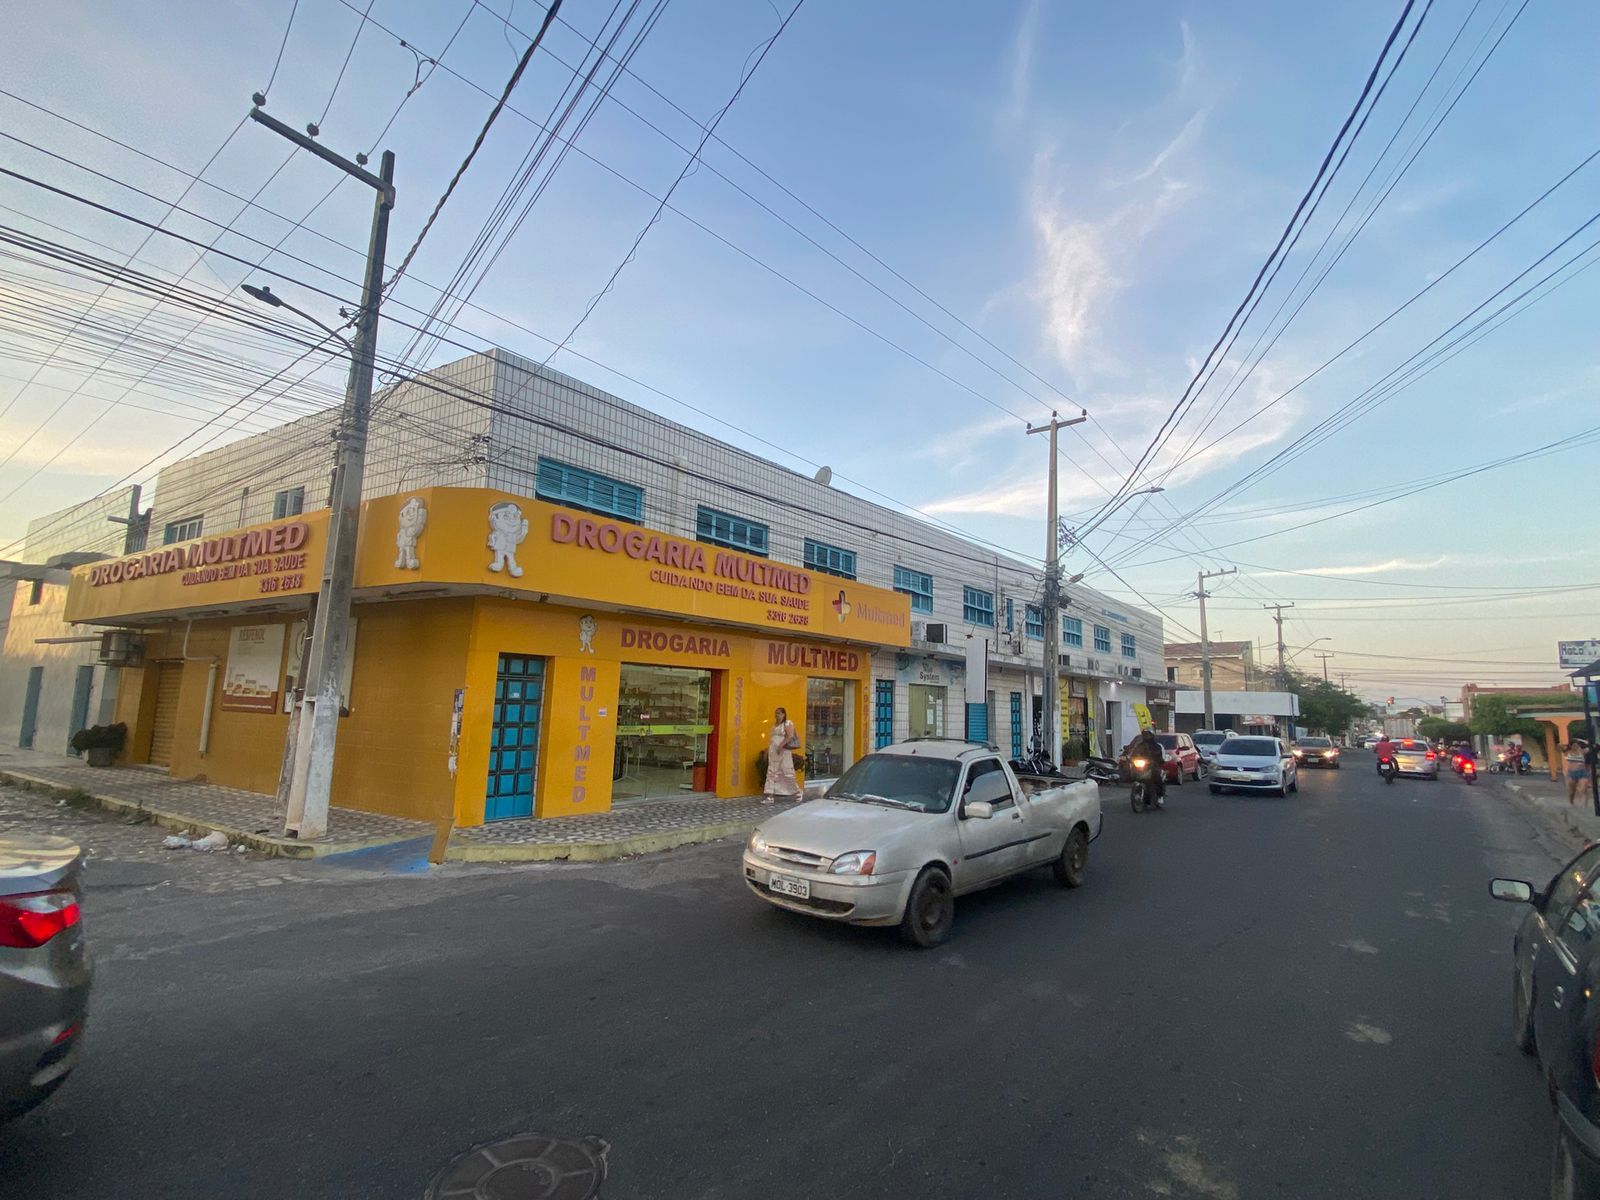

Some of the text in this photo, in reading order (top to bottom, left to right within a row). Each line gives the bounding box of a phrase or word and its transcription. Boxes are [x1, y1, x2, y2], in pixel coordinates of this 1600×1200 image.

[90, 521, 308, 586] DROGARIA MULTMED
[552, 511, 811, 594] DROGARIA MULTMED
[650, 569, 809, 610] CUIDANDO BEM DA SUA SAUDE
[621, 628, 859, 672] DROGARIA MULTMED
[920, 671, 940, 681] System
[572, 666, 596, 803] MULTMED
